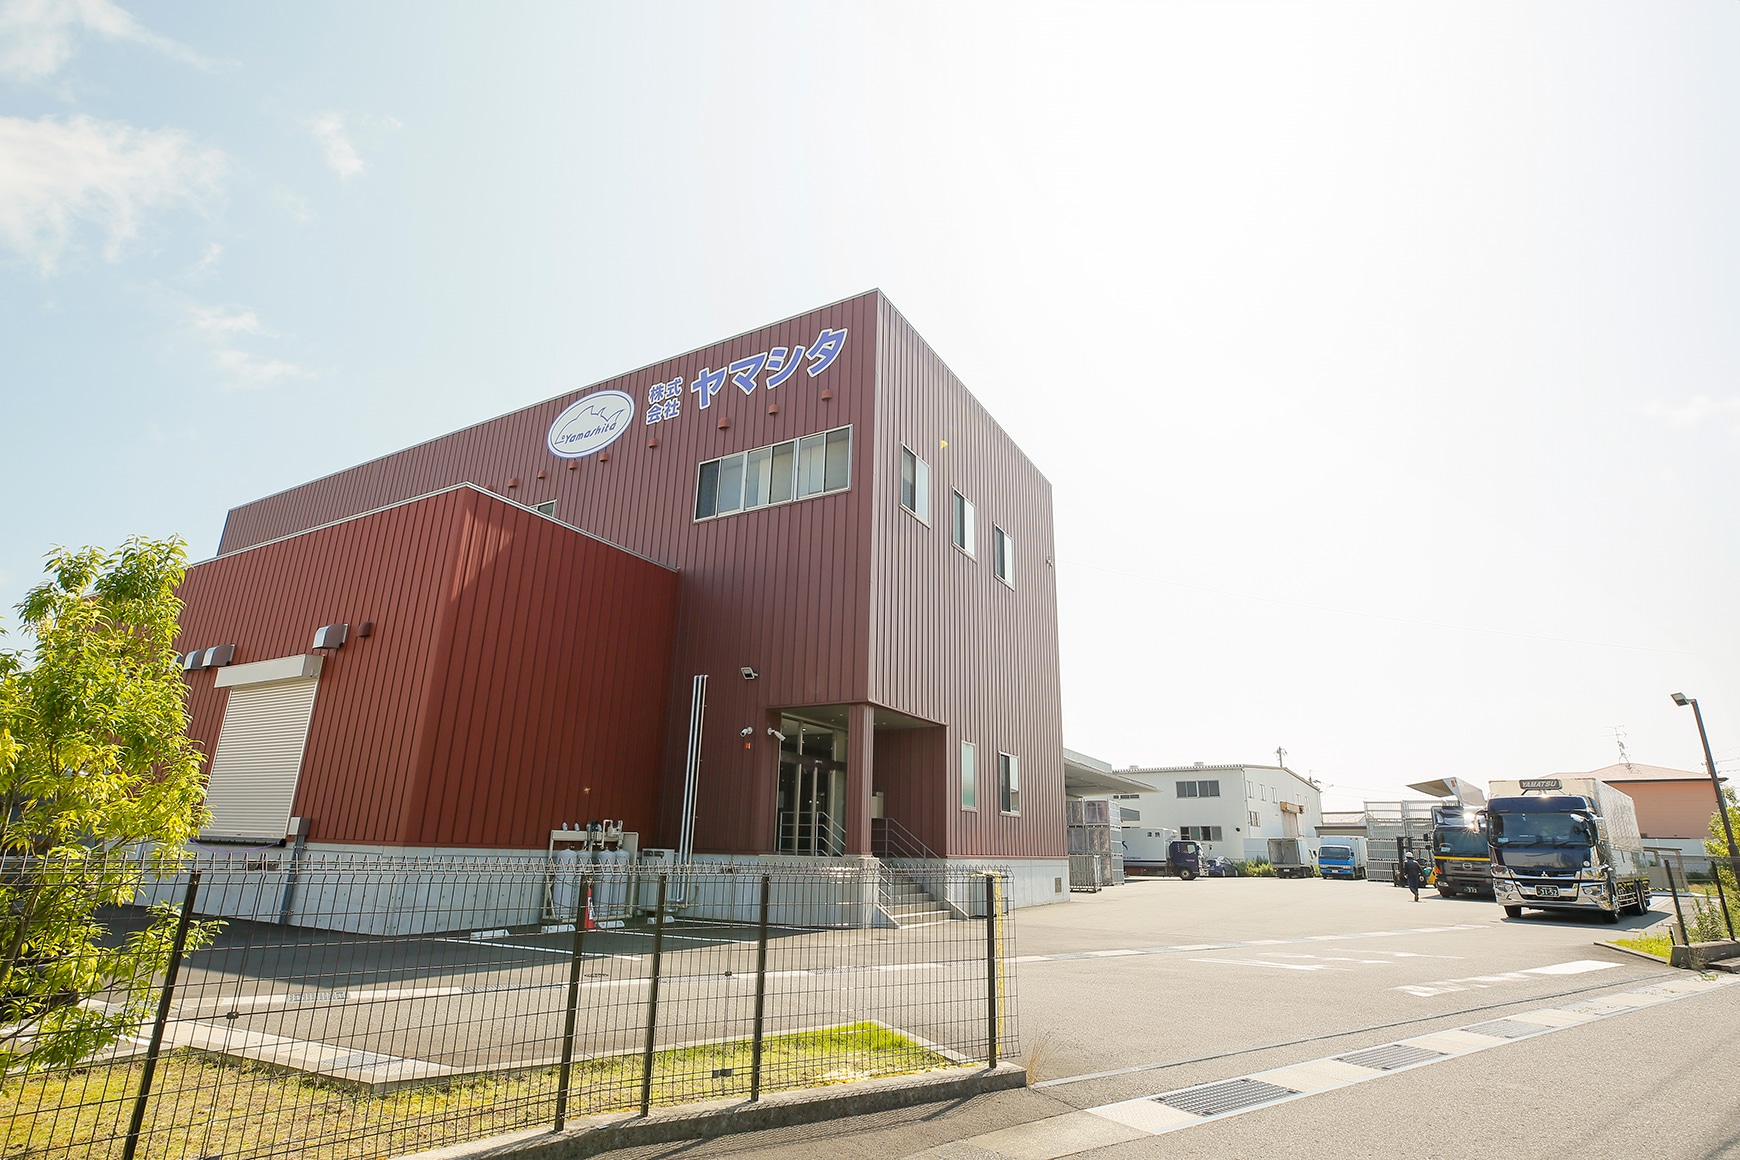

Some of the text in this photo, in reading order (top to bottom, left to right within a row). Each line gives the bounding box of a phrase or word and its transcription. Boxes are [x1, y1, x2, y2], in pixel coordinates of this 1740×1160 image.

[691, 328, 848, 410] ヤマシタ
[648, 376, 683, 405] 株式
[646, 398, 681, 425] 会社
[564, 421, 617, 445] Yamashita
[1522, 780, 1557, 788] YAMATSU
